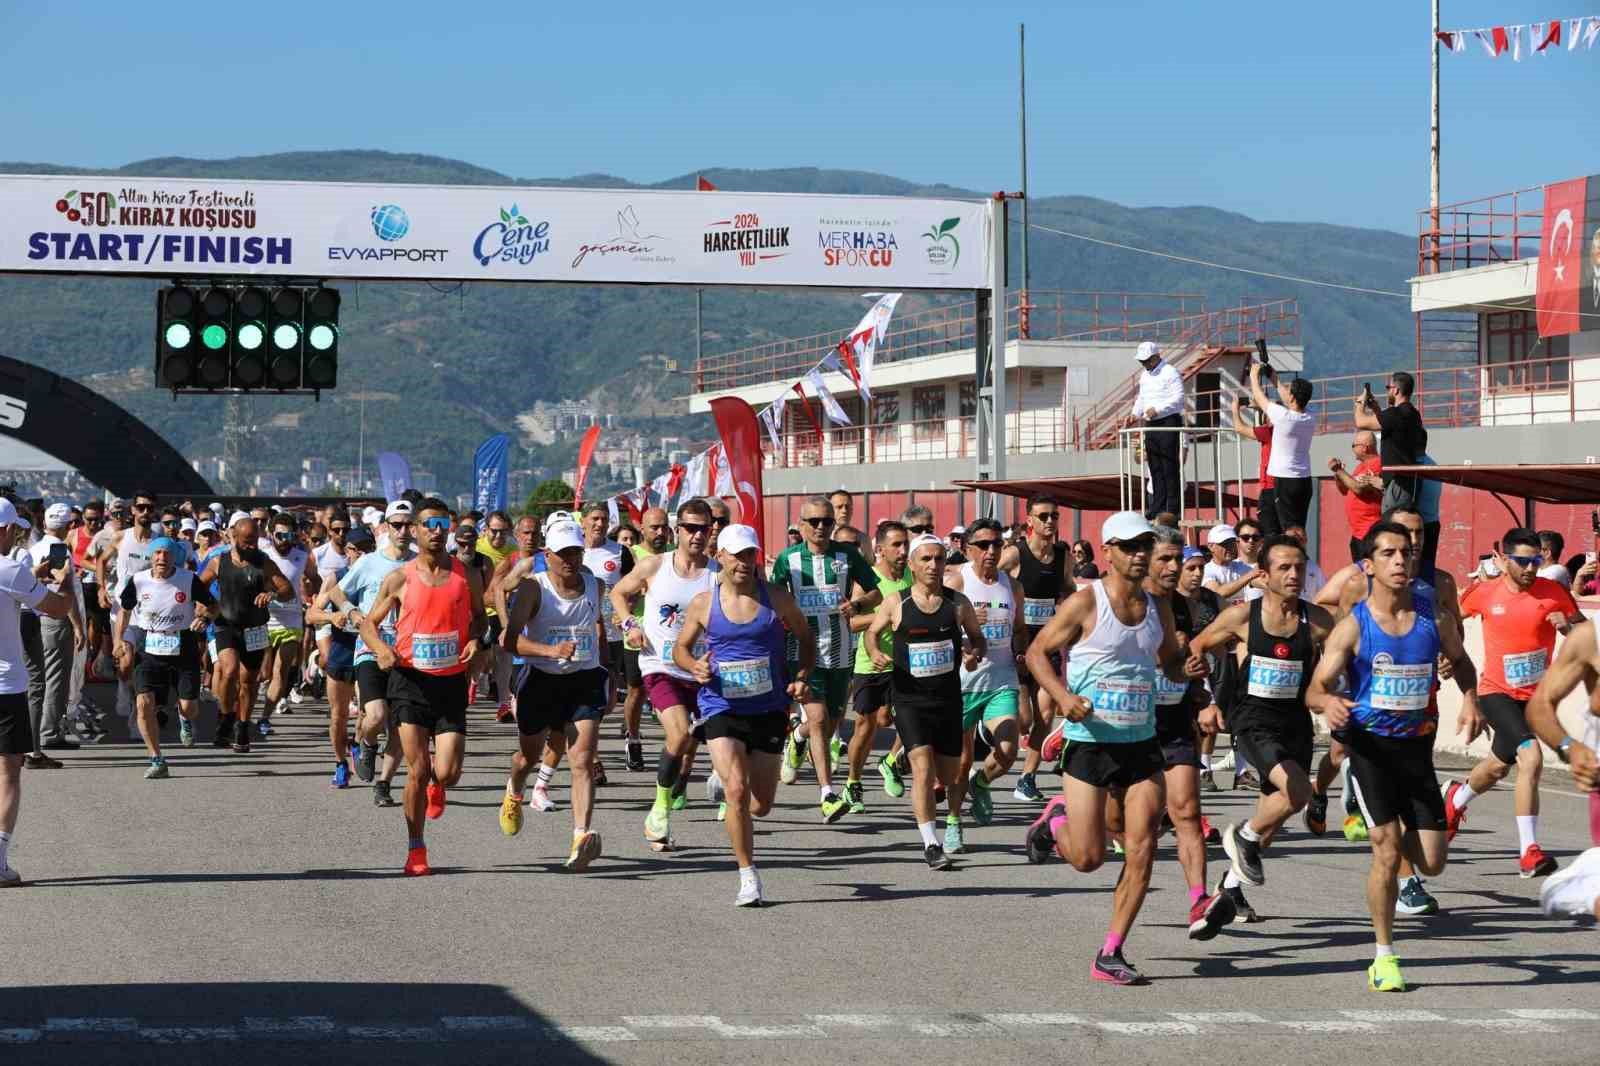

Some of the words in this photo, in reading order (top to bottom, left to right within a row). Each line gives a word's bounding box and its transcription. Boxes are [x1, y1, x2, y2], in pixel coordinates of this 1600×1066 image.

[152, 191, 184, 205] Kiraz
[188, 190, 255, 207] Festivali
[119, 207, 175, 226] KİRAZ
[179, 208, 256, 231] KOŞUSU
[734, 214, 759, 229] 2024
[27, 232, 292, 265] START/FINISH
[703, 227, 790, 253] HAREKETLİLİK
[818, 231, 899, 250] MERHABA
[328, 247, 448, 262] EVYAPPORT
[501, 238, 550, 266] suyu
[740, 252, 756, 266] YILI
[824, 248, 892, 267] SPORCU
[1374, 678, 1429, 696] 41022
[1096, 692, 1149, 711] 41048
